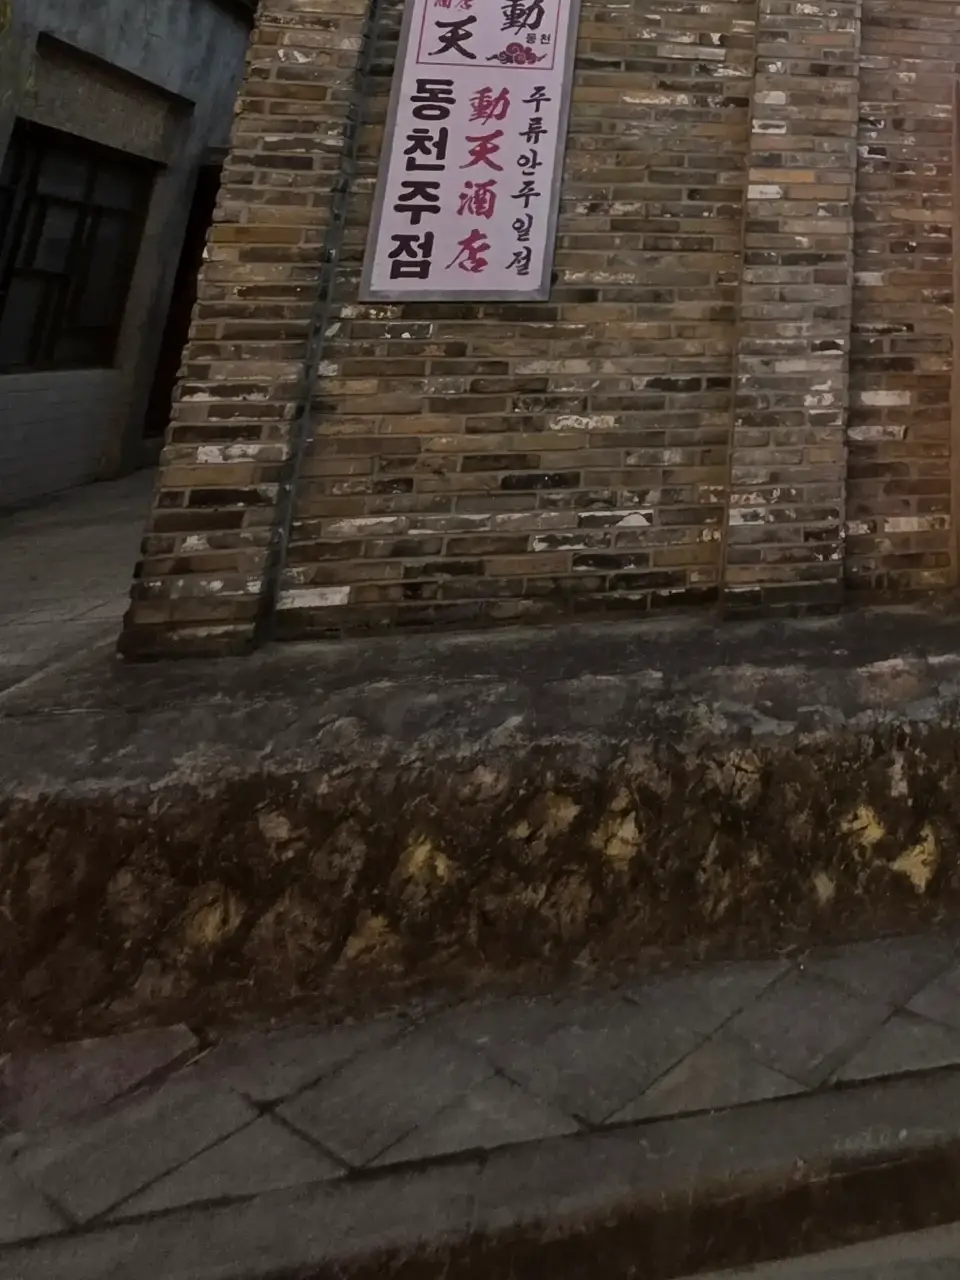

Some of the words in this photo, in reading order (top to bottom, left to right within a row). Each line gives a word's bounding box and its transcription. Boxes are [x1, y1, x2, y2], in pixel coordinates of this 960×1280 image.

[388, 78, 456, 280] 동천주점
[445, 86, 511, 274] 動天酒店
